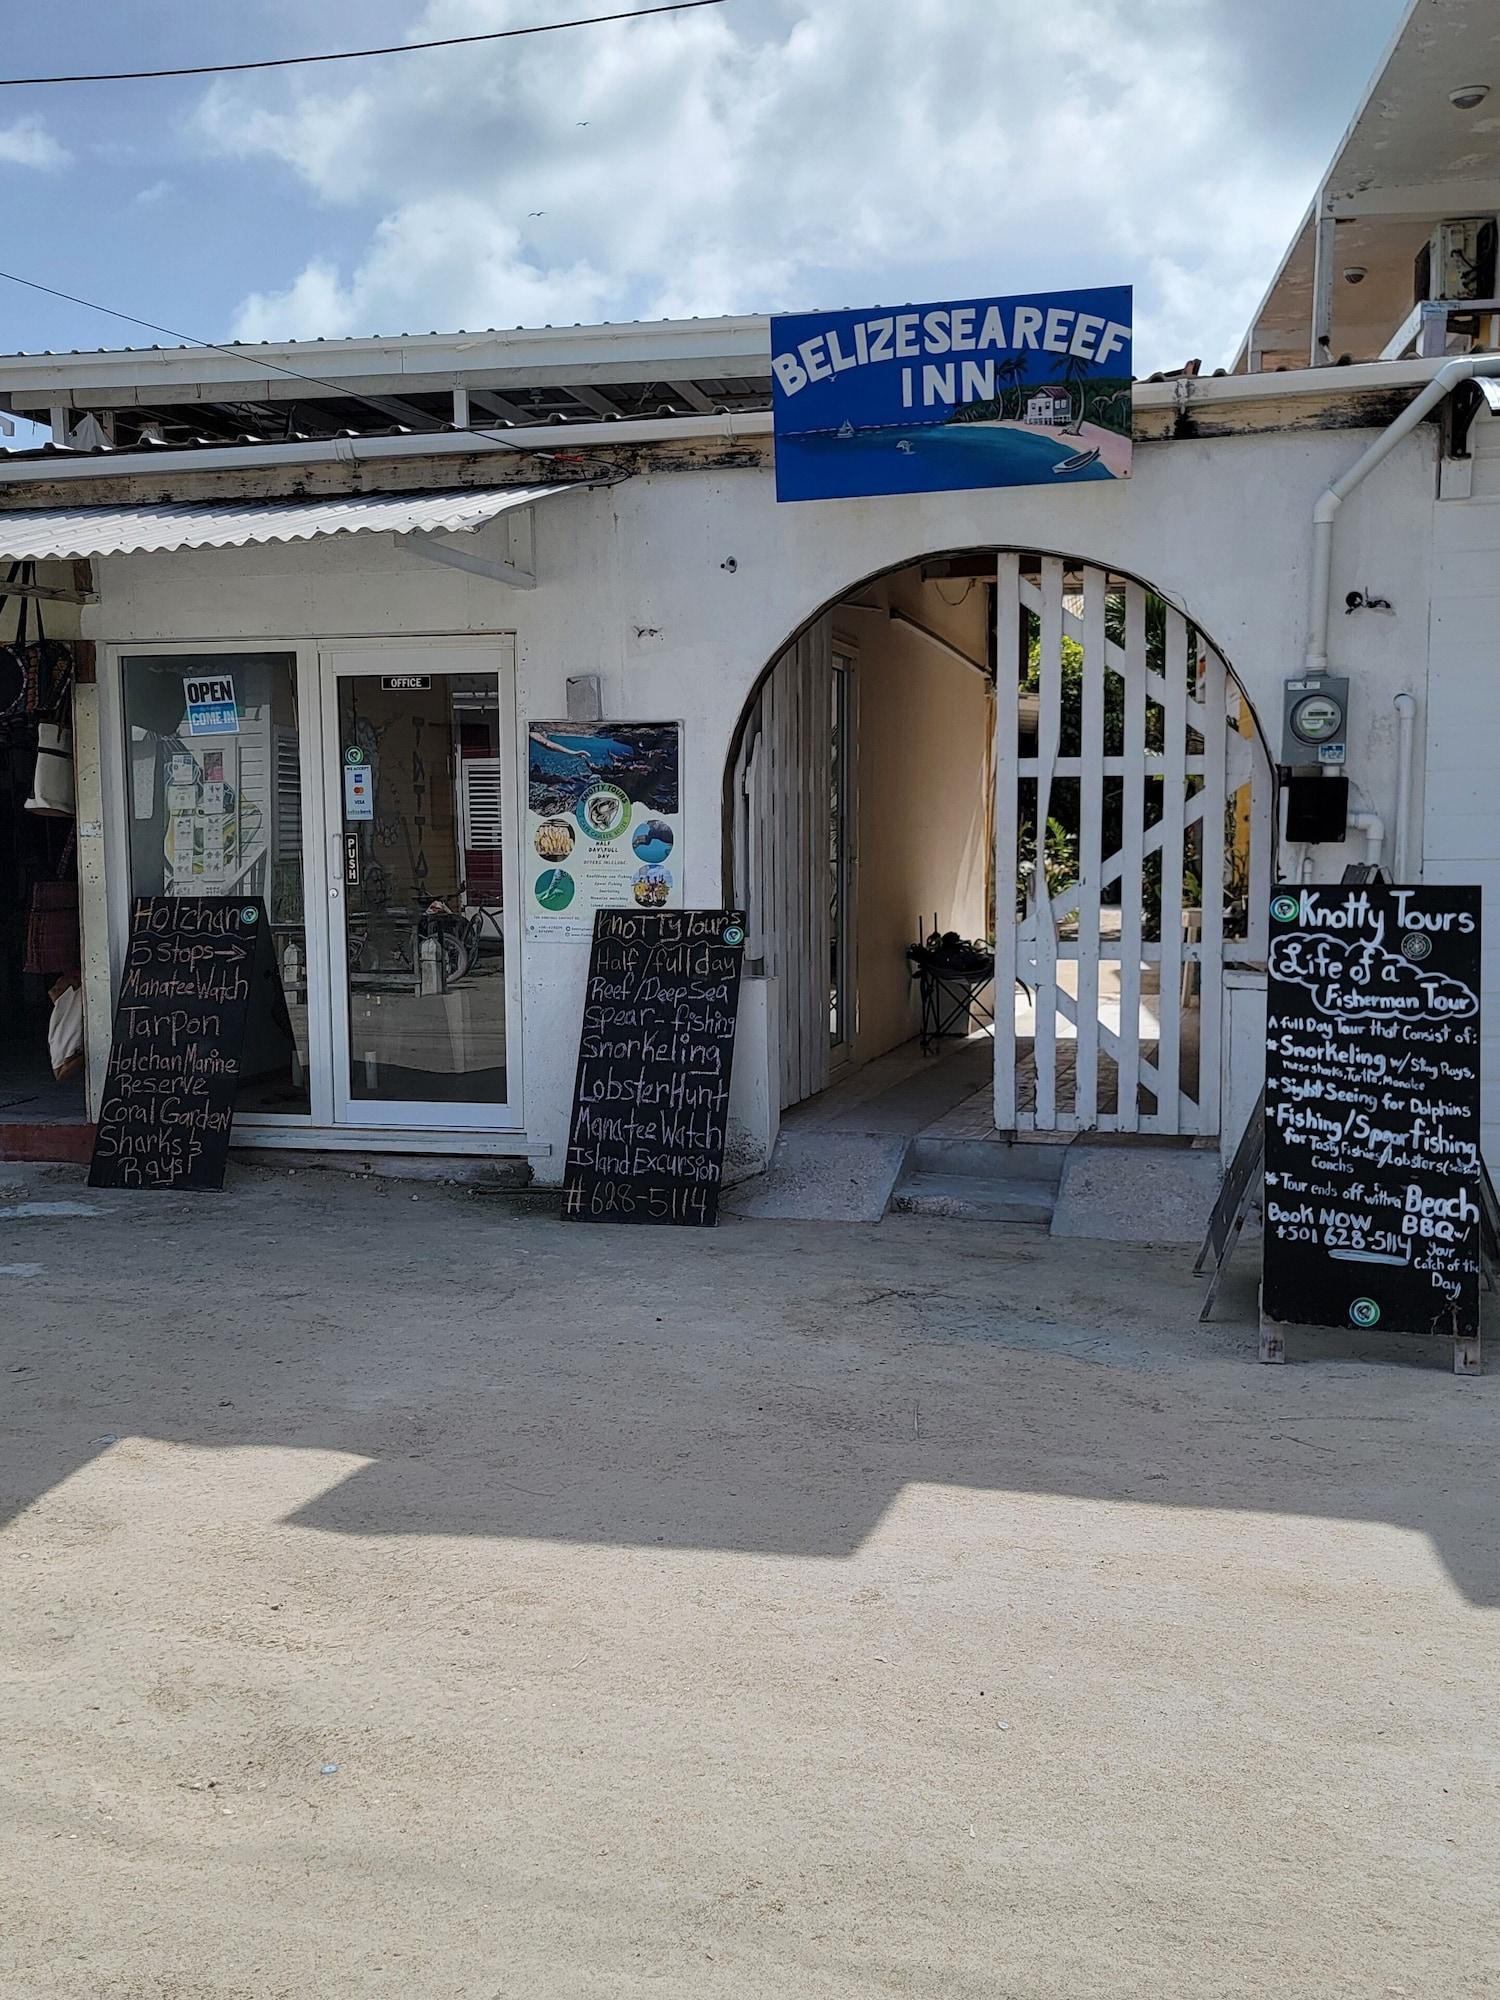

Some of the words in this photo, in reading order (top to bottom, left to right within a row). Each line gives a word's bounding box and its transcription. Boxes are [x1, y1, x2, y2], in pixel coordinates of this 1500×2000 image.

[901, 359, 995, 408] INN
[187, 680, 233, 703] OPEN
[390, 677, 422, 688] OFFICE
[191, 711, 222, 726] COME
[223, 710, 236, 724] IN
[347, 838, 357, 880] PUSH
[1299, 888, 1385, 947] Knotty
[1388, 889, 1476, 934] Tours
[131, 940, 152, 966] 5
[158, 935, 214, 973] Stops
[1280, 942, 1343, 980] Life
[1349, 946, 1375, 985] of
[1381, 963, 1401, 982] a
[1323, 983, 1420, 1010] Fisherman
[1420, 982, 1471, 1011] Tour
[120, 1005, 220, 1046] Tarpon
[1268, 1015, 1279, 1029] A
[1306, 1017, 1333, 1040] Day
[1333, 1016, 1367, 1035] Tour
[1369, 1018, 1400, 1039] that
[1402, 1023, 1452, 1044] Consist
[114, 1073, 210, 1098] Reserve
[102, 1097, 155, 1126] Coral
[1324, 1081, 1379, 1114] Seeing
[1381, 1092, 1406, 1111] for
[1410, 1097, 1471, 1125] Dolphins
[660, 1109, 721, 1150] Watch
[1282, 1126, 1308, 1146] for
[567, 1142, 631, 1176] Island
[1311, 1155, 1355, 1174] Conchs
[1279, 1171, 1308, 1193] Tour
[1310, 1180, 1338, 1197] ends
[1342, 1182, 1366, 1201] off
[1405, 1183, 1480, 1224] Beach
[1268, 1201, 1315, 1225] Book
[1319, 1207, 1373, 1233] NOW
[1401, 1214, 1455, 1243] BBQ
[1275, 1224, 1318, 1244] +501
[1323, 1226, 1412, 1261] 628-5114
[1413, 1257, 1445, 1270] Catch
[1447, 1258, 1460, 1272] of
[1431, 1271, 1462, 1301] Day
